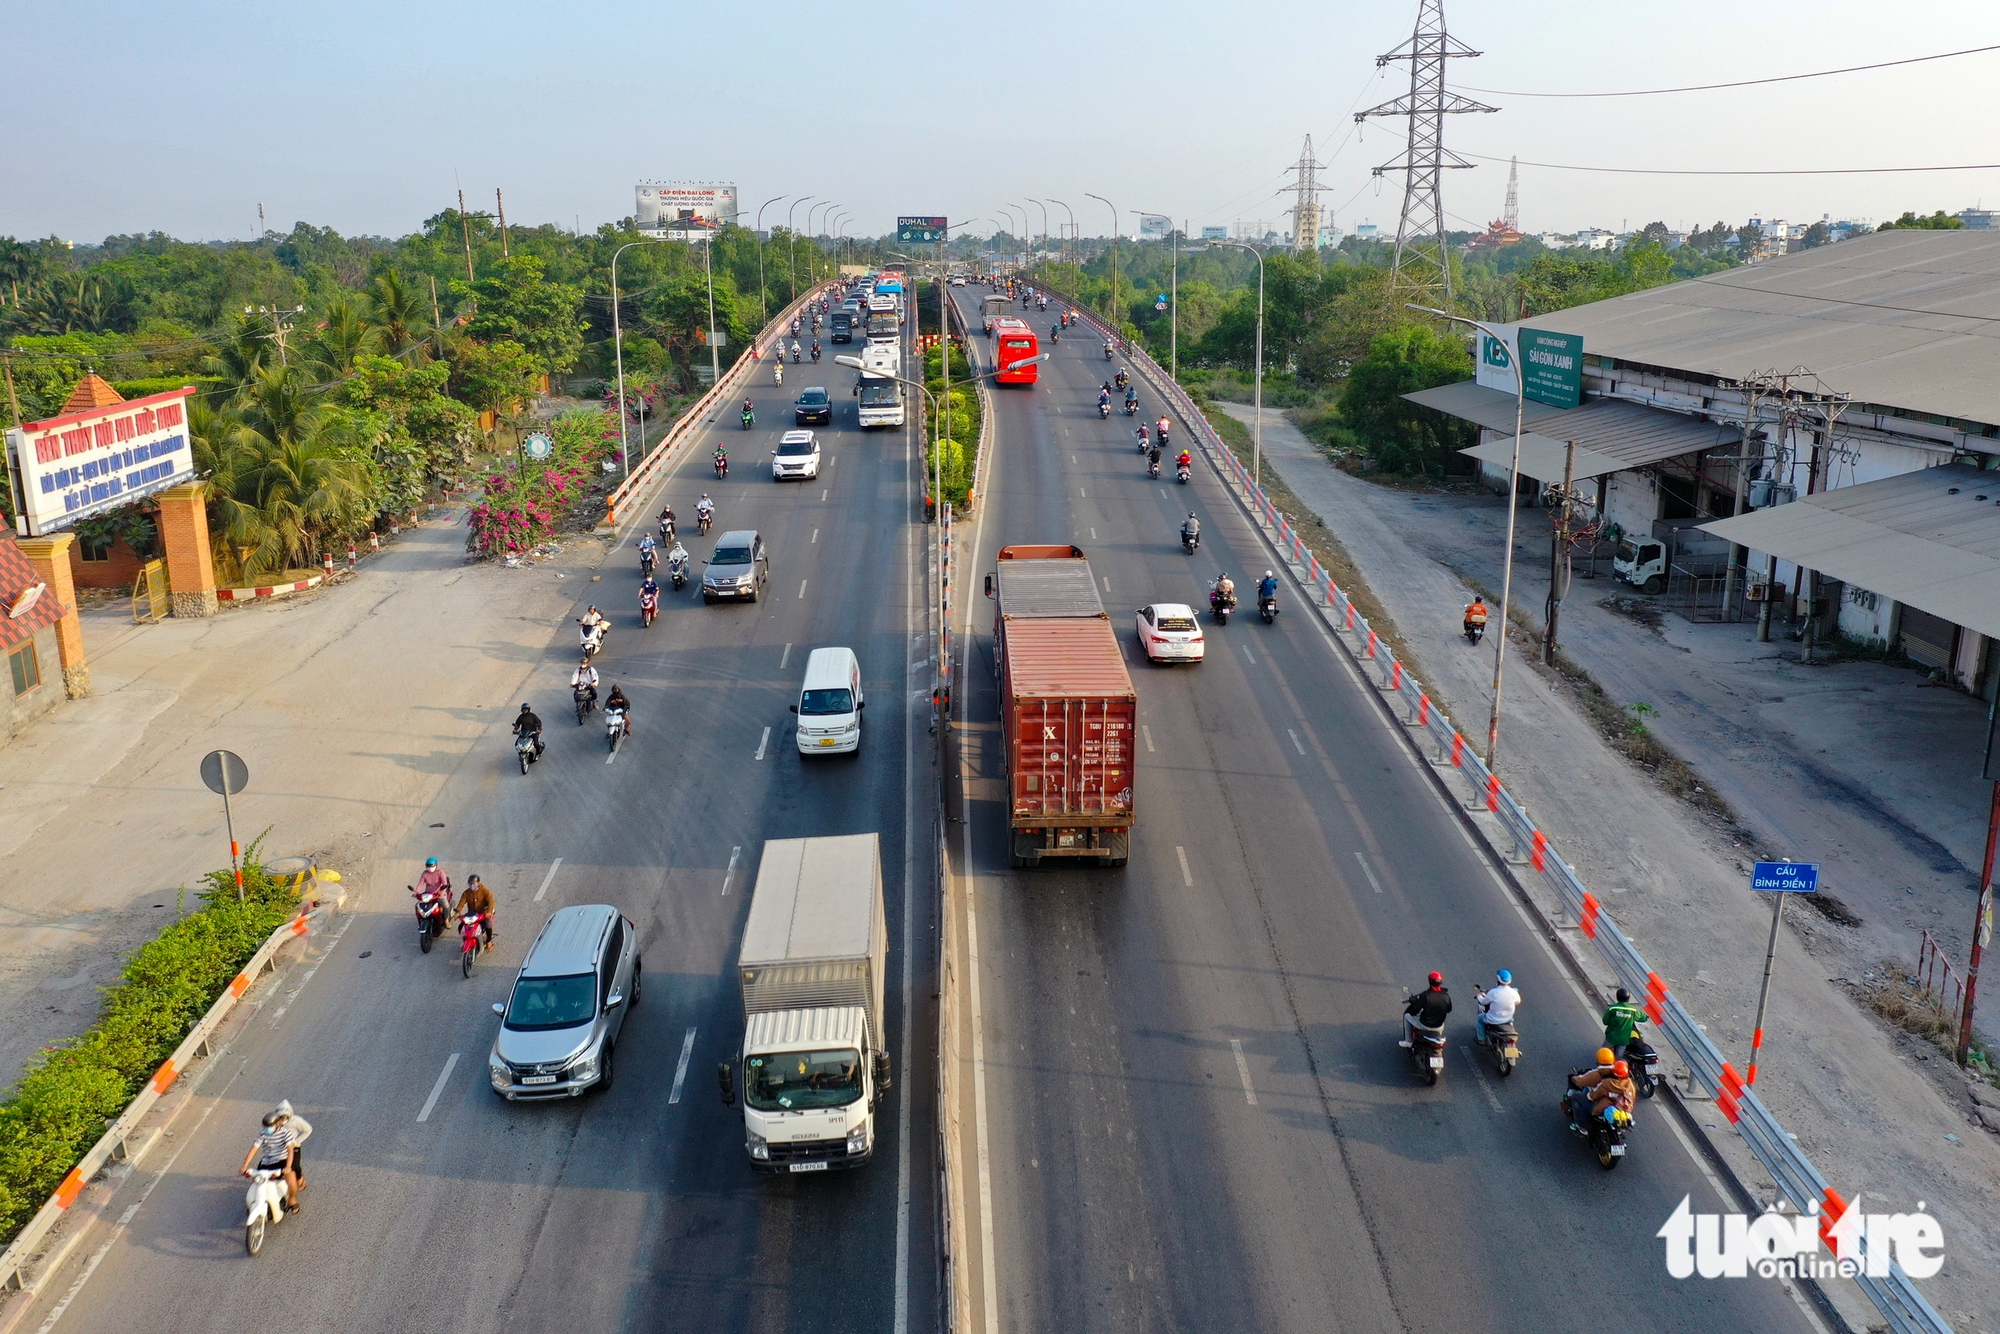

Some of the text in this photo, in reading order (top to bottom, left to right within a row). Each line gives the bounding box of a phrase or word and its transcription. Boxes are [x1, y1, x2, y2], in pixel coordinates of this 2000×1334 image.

[900, 218, 945, 226] DUHAL LED
[1529, 347, 1572, 370] SÀI GÒN XANH
[35, 403, 184, 464] BẾN THỦY NỘI ĐỊA ĐỨC HẠNH
[1776, 864, 1796, 876] CẦU
[1755, 877, 1813, 888] BÌNH ĐIỀN 1
